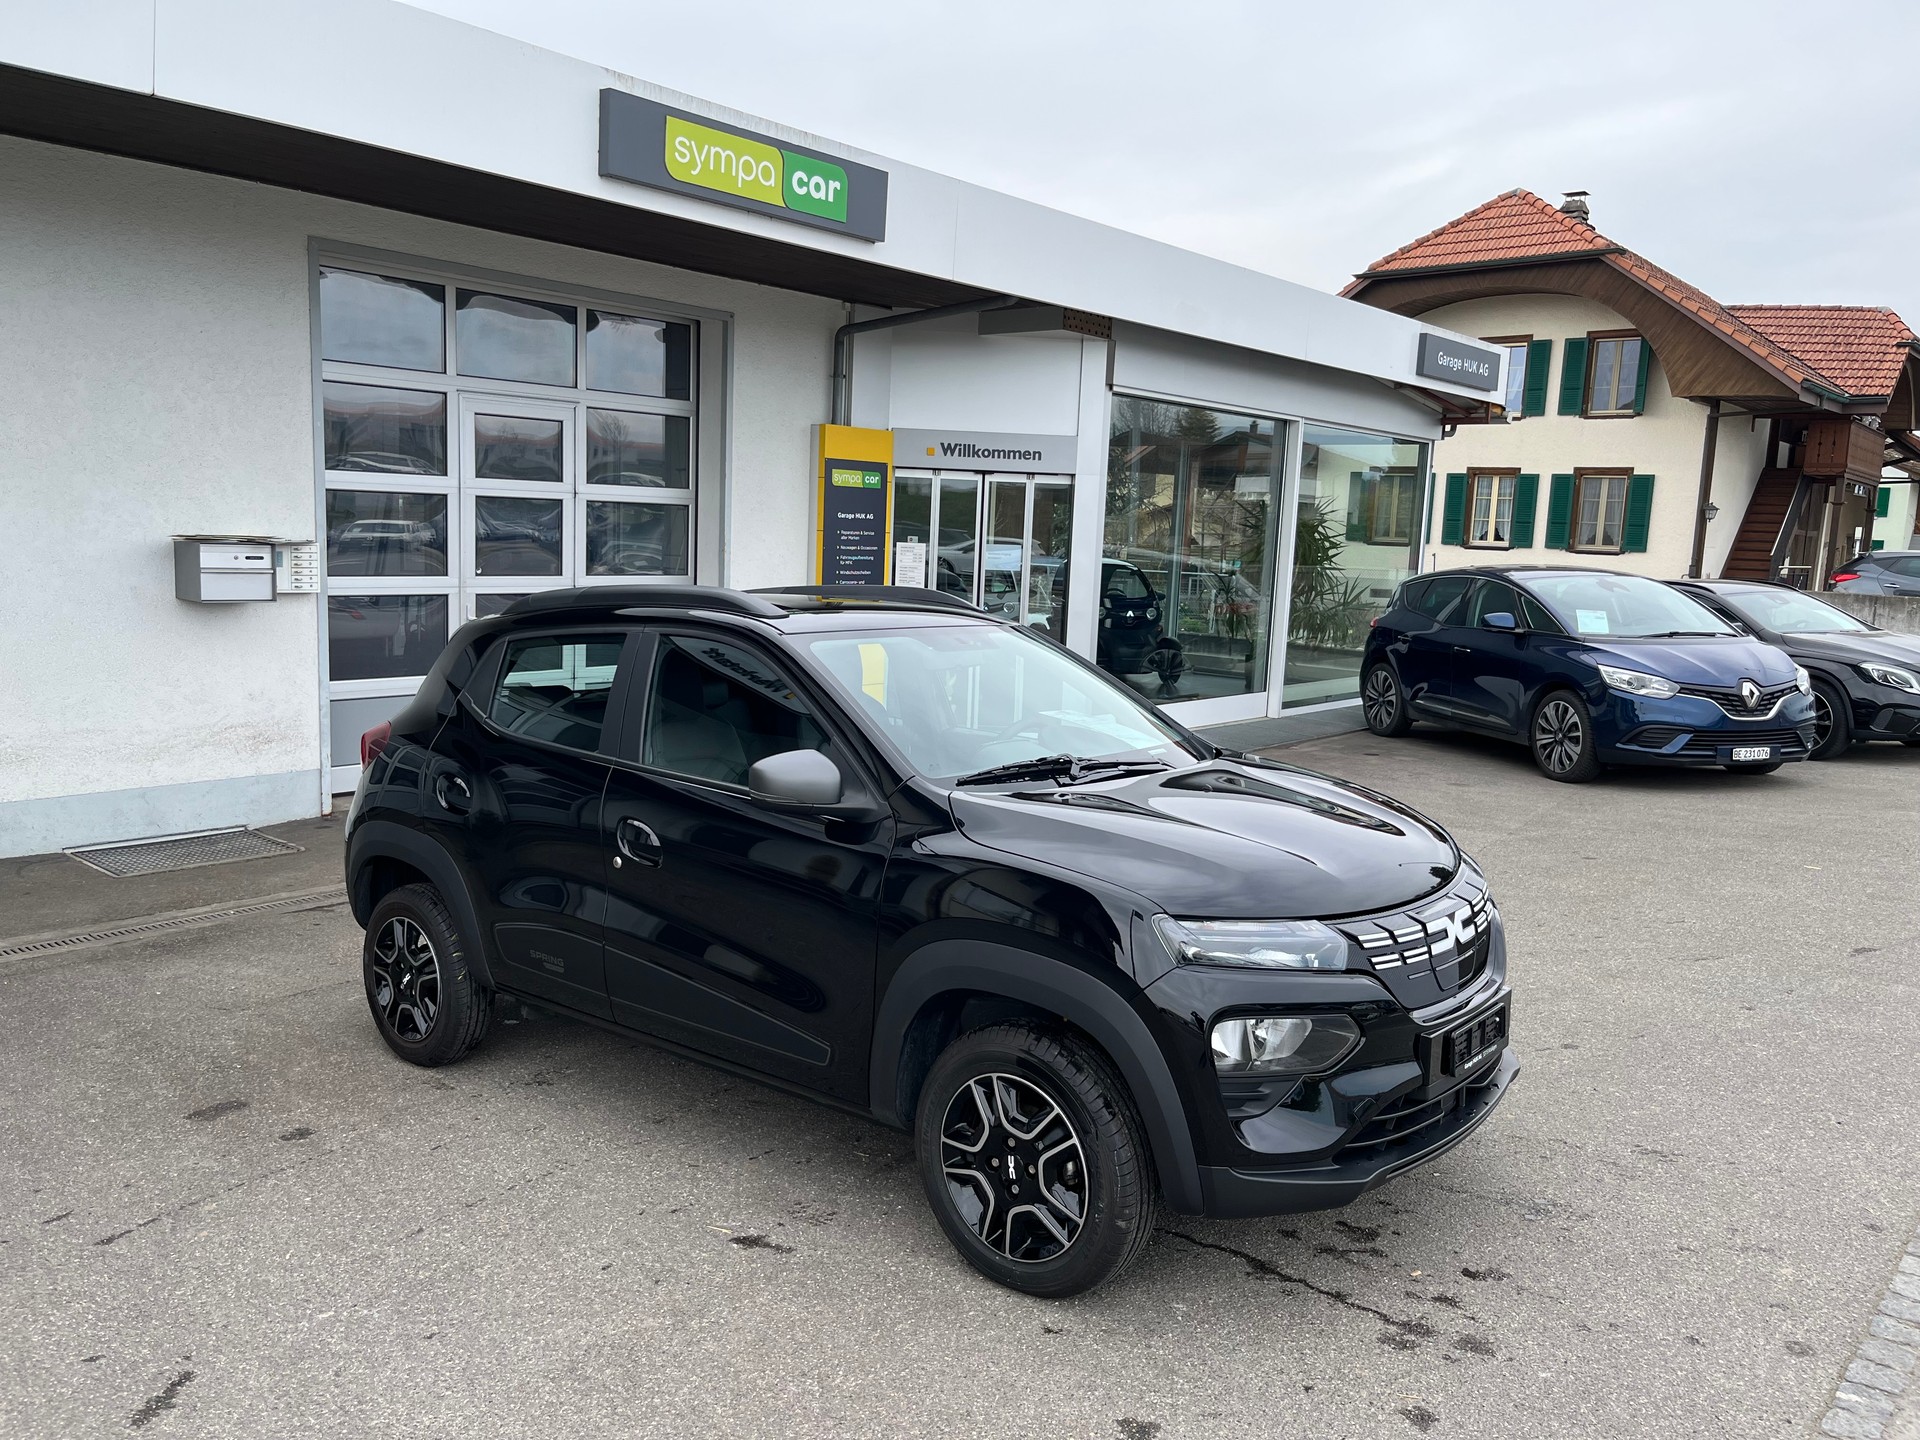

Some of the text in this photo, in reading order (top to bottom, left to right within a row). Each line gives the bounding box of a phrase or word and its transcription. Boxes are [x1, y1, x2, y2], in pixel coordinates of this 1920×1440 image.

[674, 136, 841, 203] sympa car
[1438, 352, 1489, 376] Garage HUK AG
[940, 442, 1042, 461] Willkommen
[834, 473, 879, 484] sympa car
[837, 512, 855, 520] Garage
[1734, 749, 1768, 758] BE 231076
[529, 949, 564, 967] SPRING
